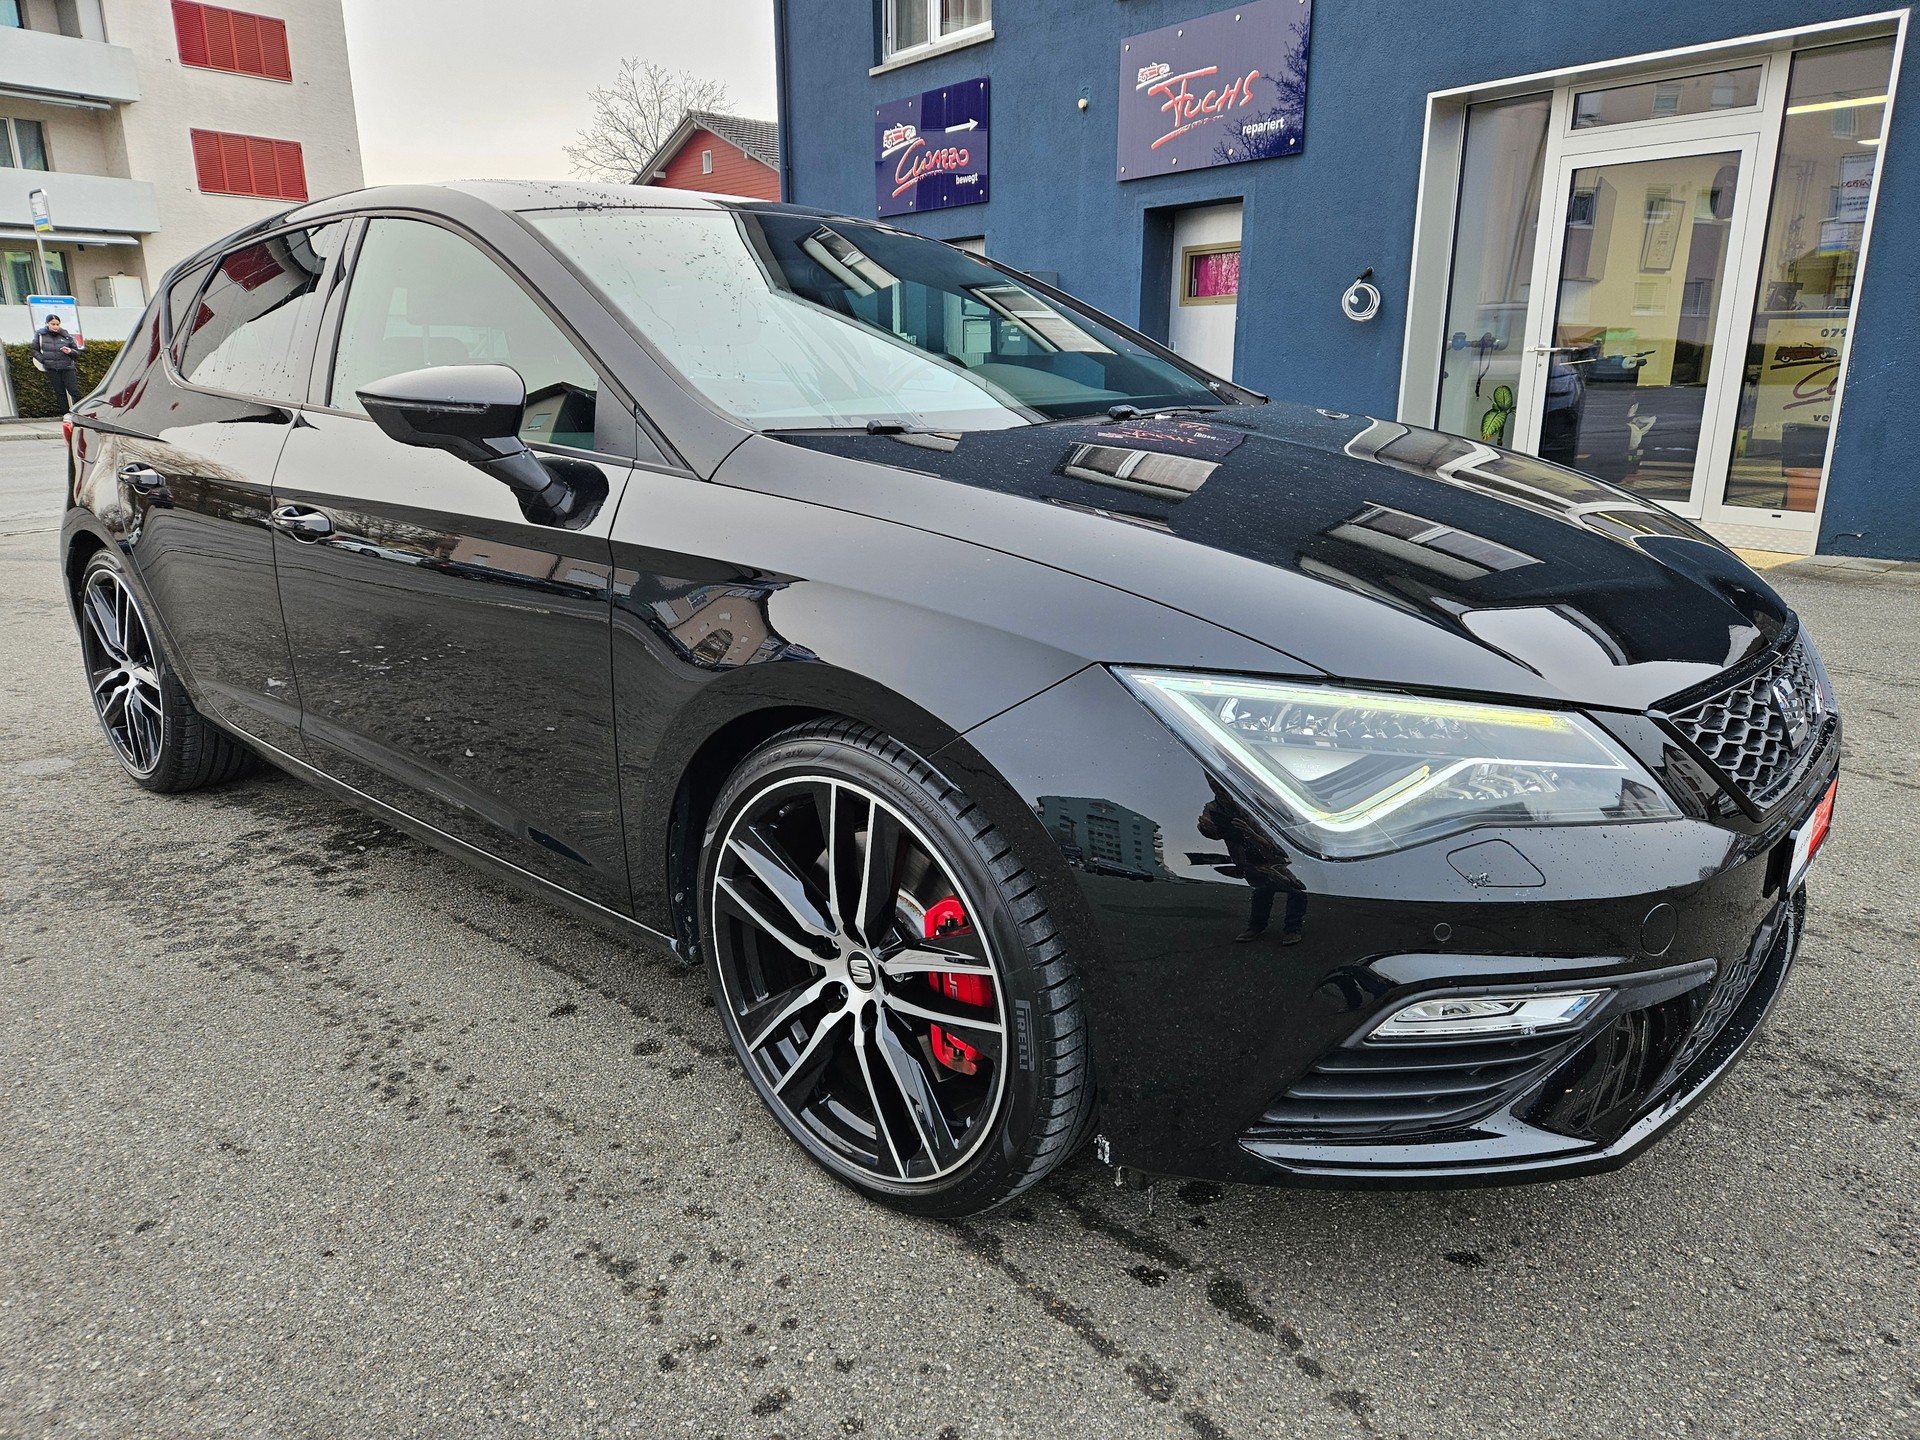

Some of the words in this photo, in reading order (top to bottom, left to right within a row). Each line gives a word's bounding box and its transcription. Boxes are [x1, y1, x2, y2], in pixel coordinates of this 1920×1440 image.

[1242, 117, 1285, 136] repariert
[956, 172, 978, 185] bewegt
[893, 777, 943, 820] OUTSIDE
[1015, 999, 1035, 1072] PIRELLI
